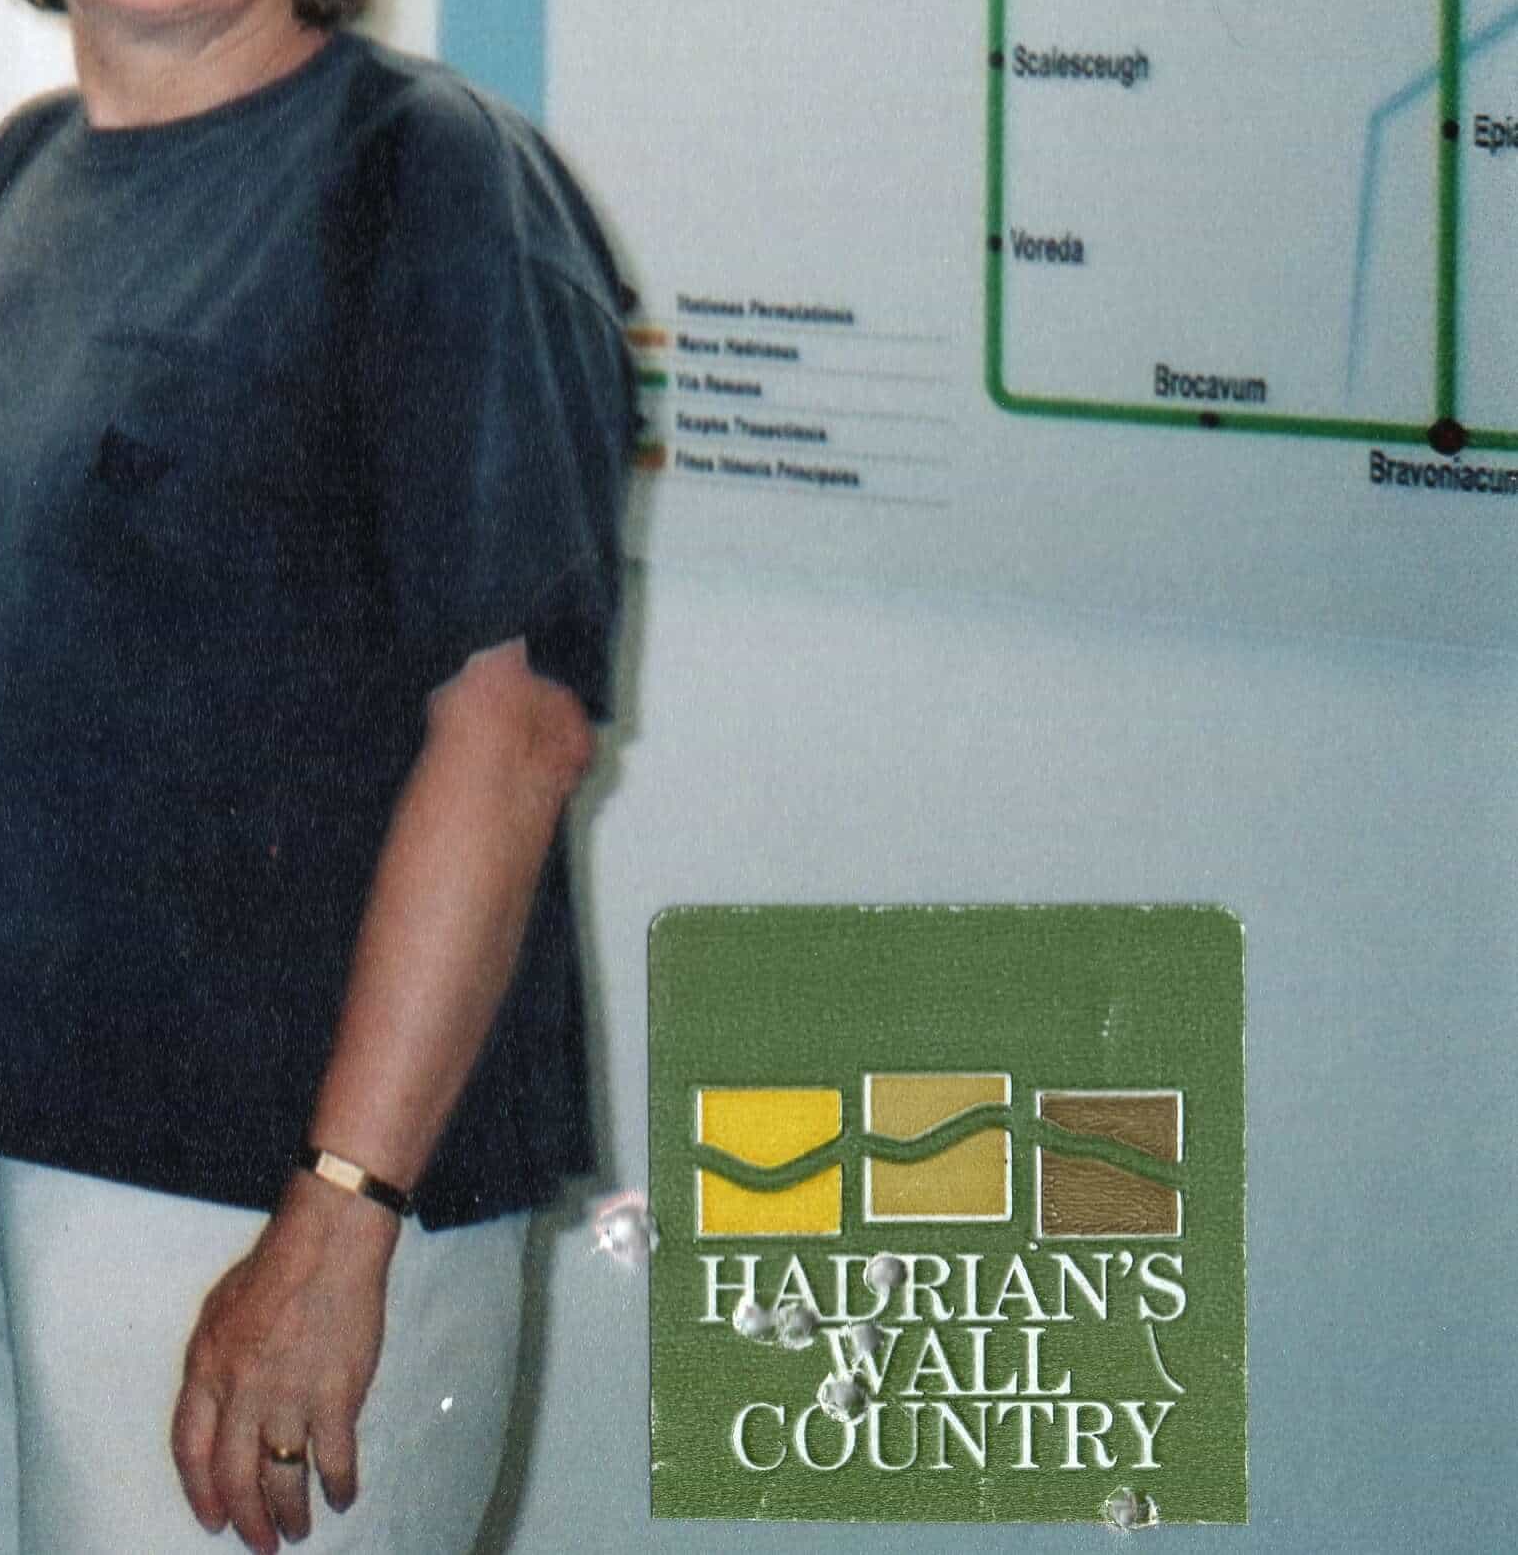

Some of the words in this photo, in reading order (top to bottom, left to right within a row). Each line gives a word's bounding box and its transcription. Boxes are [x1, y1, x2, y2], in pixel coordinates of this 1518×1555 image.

[1475, 113, 1518, 157] Epi
[1010, 230, 1085, 263] Voreda
[1154, 364, 1267, 402] Brocavum
